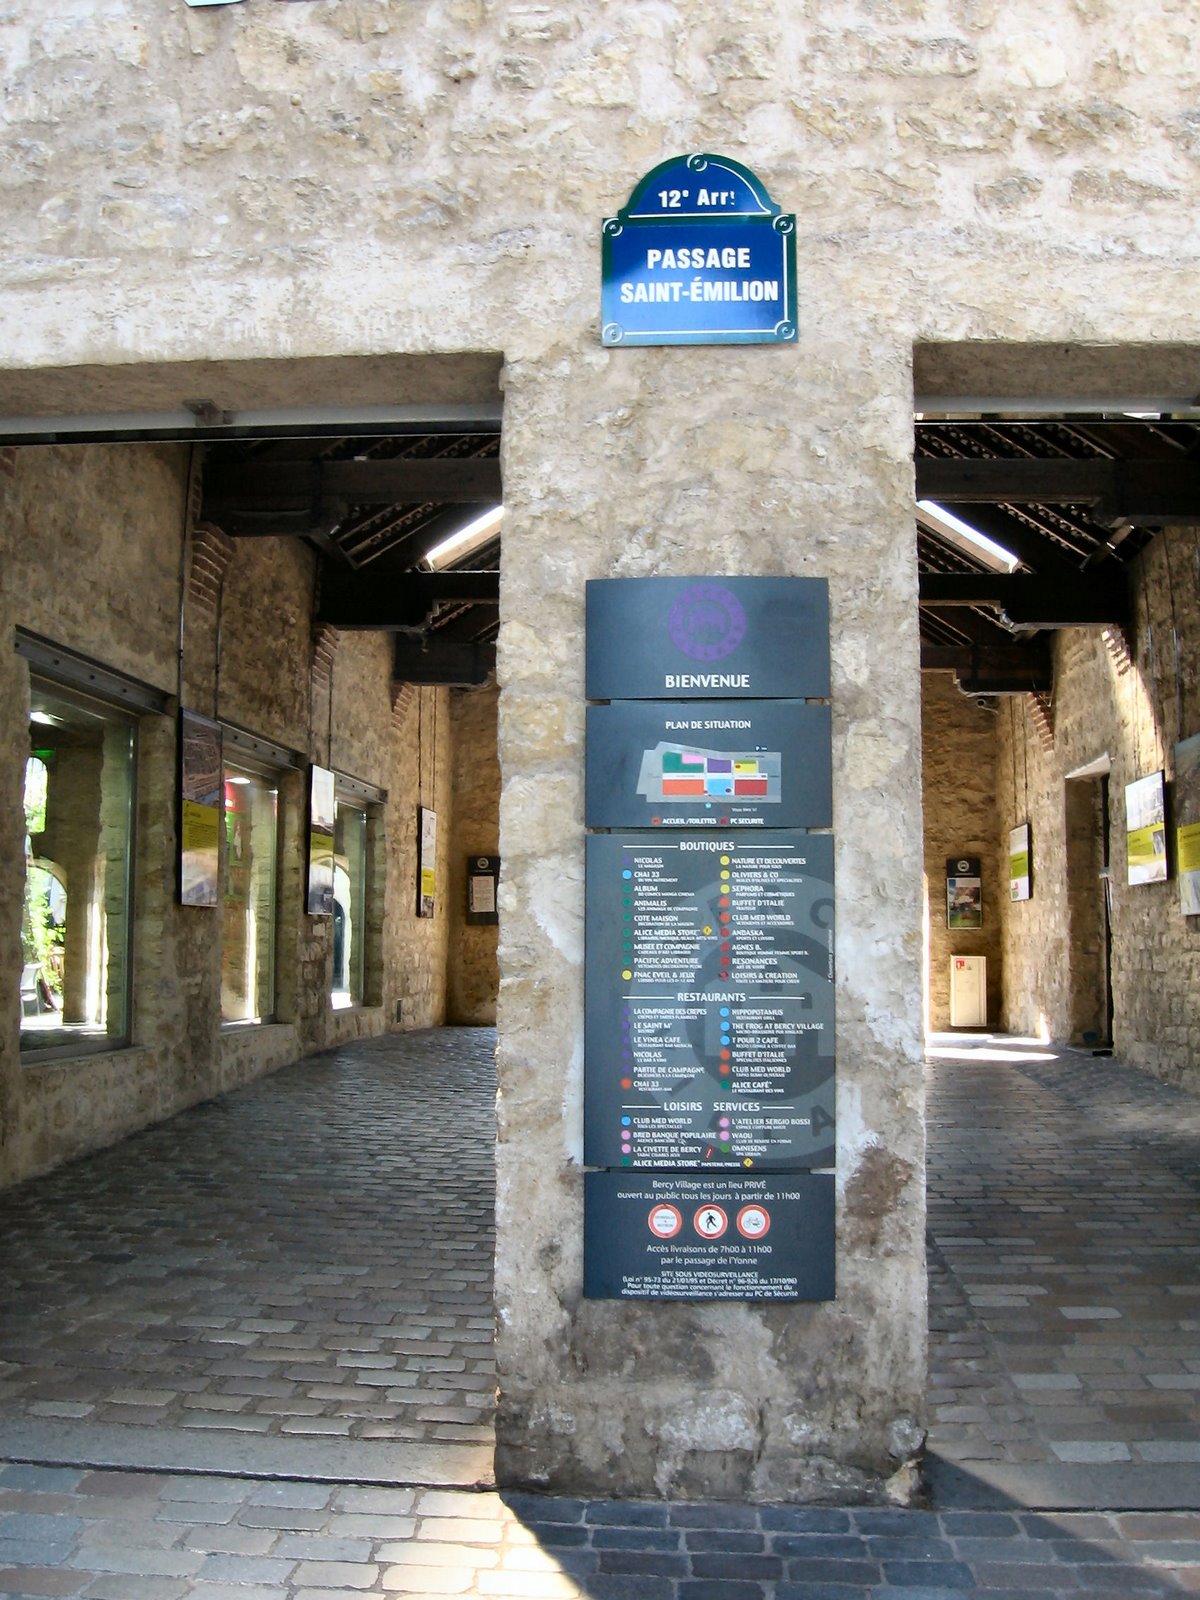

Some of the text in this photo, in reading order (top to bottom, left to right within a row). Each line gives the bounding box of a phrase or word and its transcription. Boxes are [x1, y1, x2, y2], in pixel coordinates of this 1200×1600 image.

[647, 248, 750, 269] PASSAGE
[621, 278, 778, 303] SAINT-ÉMILION
[666, 675, 750, 688] BIENVENUE
[680, 842, 734, 852] BOUTIQUES
[677, 993, 746, 1002] RESTAURANTS
[664, 1102, 702, 1111] LOISIRS
[713, 1102, 760, 1112] SERVICES
[653, 1180, 674, 1190] Bercy
[675, 1181, 701, 1190] Village
[744, 1180, 766, 1189] PRIVÉ
[656, 1192, 679, 1200] public
[712, 1193, 731, 1201] jours
[741, 1193, 762, 1201] partir
[671, 1245, 706, 1253] livraisons
[661, 1257, 674, 1265] par
[684, 1257, 716, 1266] passage
